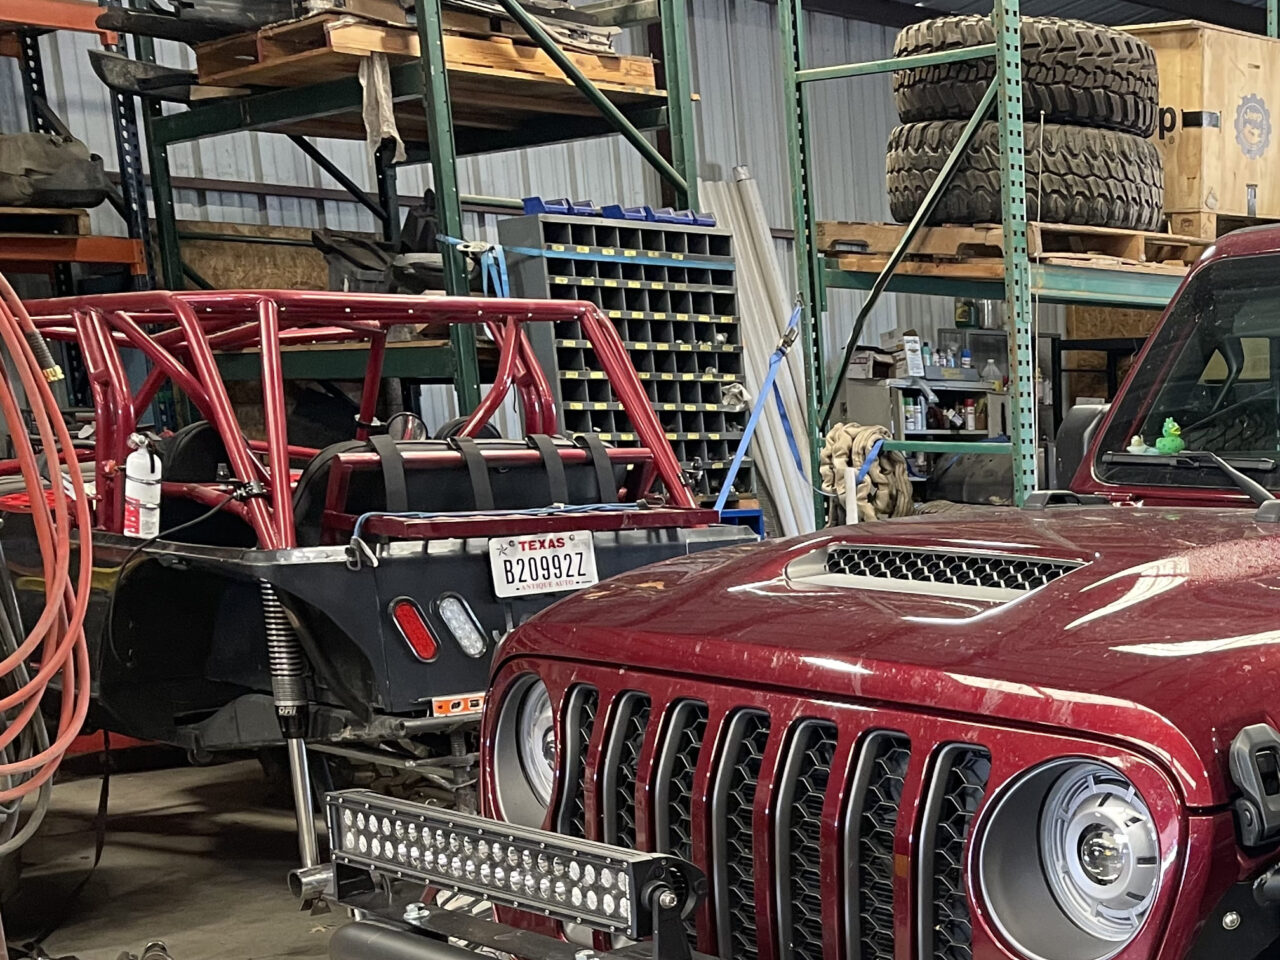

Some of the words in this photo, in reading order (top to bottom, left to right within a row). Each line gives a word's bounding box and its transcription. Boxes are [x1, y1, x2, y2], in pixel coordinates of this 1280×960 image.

[518, 537, 566, 552] TEXAS
[503, 552, 587, 585] B20992Z
[521, 582, 553, 591] ANTIQUE
[555, 579, 574, 588] AUTO
